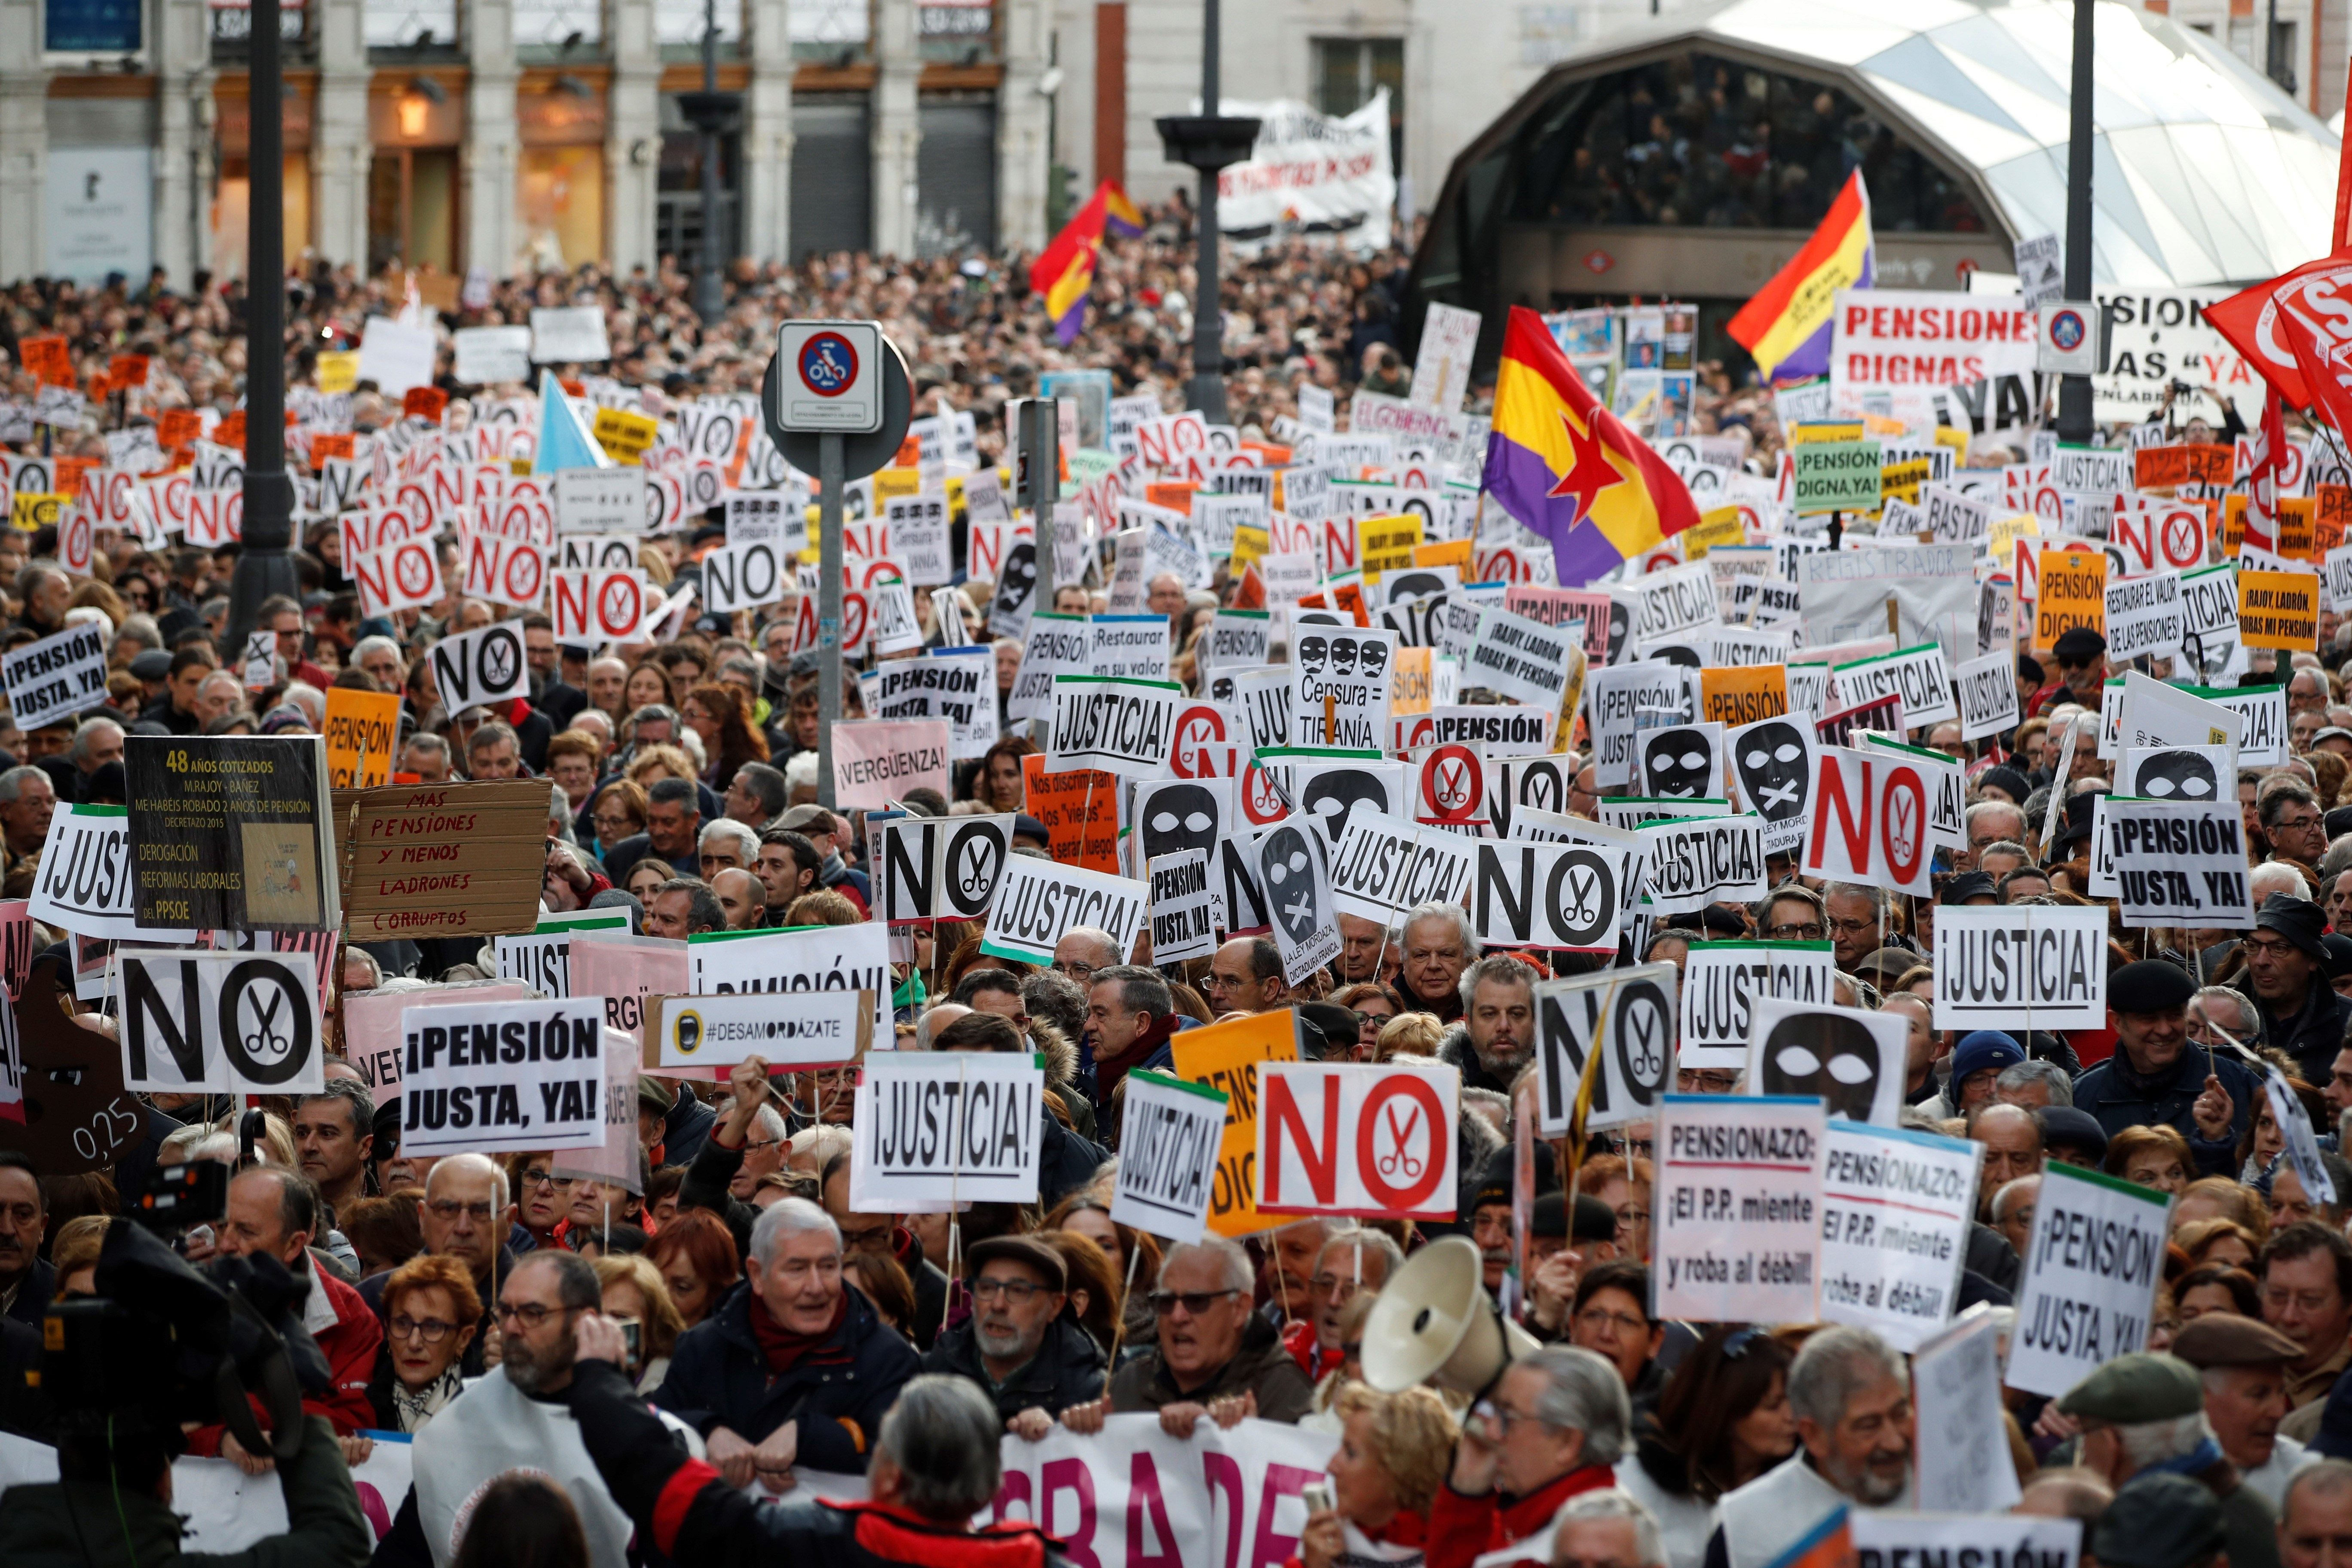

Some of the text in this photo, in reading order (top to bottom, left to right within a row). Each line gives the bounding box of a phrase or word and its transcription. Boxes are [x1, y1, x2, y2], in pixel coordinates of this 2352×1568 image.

[1849, 353, 1983, 387] DIGNAS
[1136, 417, 1204, 467] NO
[1797, 447, 1878, 475] ¡PENSIÓN
[2052, 453, 2125, 493] ¡JUSTICIA!
[2114, 511, 2204, 570] NO
[354, 544, 435, 614] NO
[468, 535, 541, 601] NO
[705, 544, 775, 612] NO
[2041, 572, 2104, 601] ¡PENSIÓN
[556, 573, 640, 636] NO
[2107, 577, 2177, 616] RESTAURAR EL VALOR
[2246, 589, 2310, 613] ¡RAJOY, LADRÓN,
[1092, 627, 1164, 652] ¡Restaurar
[1489, 623, 1525, 649] ¡RAJOY,
[1525, 633, 1564, 665] LADRÓN,
[2110, 614, 2179, 653] DE LAS PENSIONES!
[2239, 615, 2315, 640] ROBAS MI PENSIÓN!
[6, 630, 102, 688] ¡PENSIÓN
[435, 628, 521, 710] NO
[1093, 658, 1164, 676] en su valor
[1473, 644, 1564, 693] ROBAS MI PENSIÓN!
[13, 665, 107, 718] JUSTA, YA!
[882, 667, 978, 699] ¡PENSIÓN
[1302, 674, 1366, 707] Censura
[1965, 664, 2016, 723] ¡JUSTICIA!
[941, 701, 973, 725] YA!
[1053, 692, 1173, 759] ¡JUSTICIA!
[1708, 683, 1786, 728] ¡PENSIÓN
[1436, 715, 1543, 744] ¡PENSIÓN
[1601, 735, 1633, 766] JUST
[167, 750, 273, 773] 48 AÑOS COTIZADOS
[839, 746, 946, 790] ¡VERGÜENZA!
[1030, 770, 1110, 794] Nos discrimnan
[135, 798, 310, 813] ME HABÉIS ROBADO 2 AÑOS DE PENSIÓN
[185, 780, 259, 793] M.RAJOY BAÑEZ
[407, 791, 448, 808] MAS
[1489, 761, 1563, 839] NO
[165, 818, 224, 828] DECRETAZO 2015
[1042, 808, 1059, 827] los
[1762, 821, 1777, 835] LEY
[1809, 754, 1926, 885] NO
[2111, 812, 2240, 858] ¡PENSIÓN
[140, 842, 198, 861] DEROGACIÓN
[402, 844, 460, 863] MENOS
[1084, 835, 1116, 859] luego!
[1332, 825, 1470, 907] ¡JUSTICIA!
[1645, 827, 1761, 894] ¡JUSTICIA!
[141, 872, 240, 889] REFORMAS LABORALES
[380, 874, 471, 896] LADRONES
[886, 821, 1006, 920] NO
[1151, 856, 1206, 906] ¡PENSIÓN
[2120, 870, 2246, 910] JUSTA, YA!
[144, 901, 190, 920] DEL PPSOE
[993, 871, 1139, 956] ¡JUSTICIA!
[1476, 844, 1616, 946] NO
[374, 910, 467, 931] CORRUPTOS
[1153, 904, 1210, 947] JUSTA, YA!
[1284, 924, 1335, 965] LA LEY MORDAZA,
[1289, 941, 1339, 982] DICTADURA FRANCA.
[1942, 928, 2098, 1003] ¡JUSTICIA!
[122, 959, 312, 1084] NO
[706, 1018, 840, 1042] #DESAMORDÁZATE
[406, 1012, 598, 1075] ¡PENSIÓN
[1541, 978, 1671, 1119] NO
[404, 1084, 530, 1132] JUSTA,
[539, 1079, 596, 1123] YA!
[873, 1080, 1032, 1168] ¡JUSTICIA!
[74, 1097, 137, 1161] 0,25
[1264, 1073, 1448, 1211] NO
[1671, 1125, 1816, 1162] PENSIONAZO:
[1120, 1097, 1220, 1206] ¡JUSTICIA!
[1825, 1147, 1966, 1201] PENSIONAZO:
[1669, 1188, 1813, 1228] ¡El P.P. miente
[1845, 1216, 1876, 1244] P.P.
[1880, 1226, 1952, 1262] miente
[2034, 1208, 2157, 1288] ¡PENSIÓN
[1667, 1253, 1812, 1290] y roba al débil!
[1866, 1278, 1885, 1307] al
[1888, 1278, 1943, 1320] débil!
[2023, 1292, 2147, 1364] JUSTA, YA!
